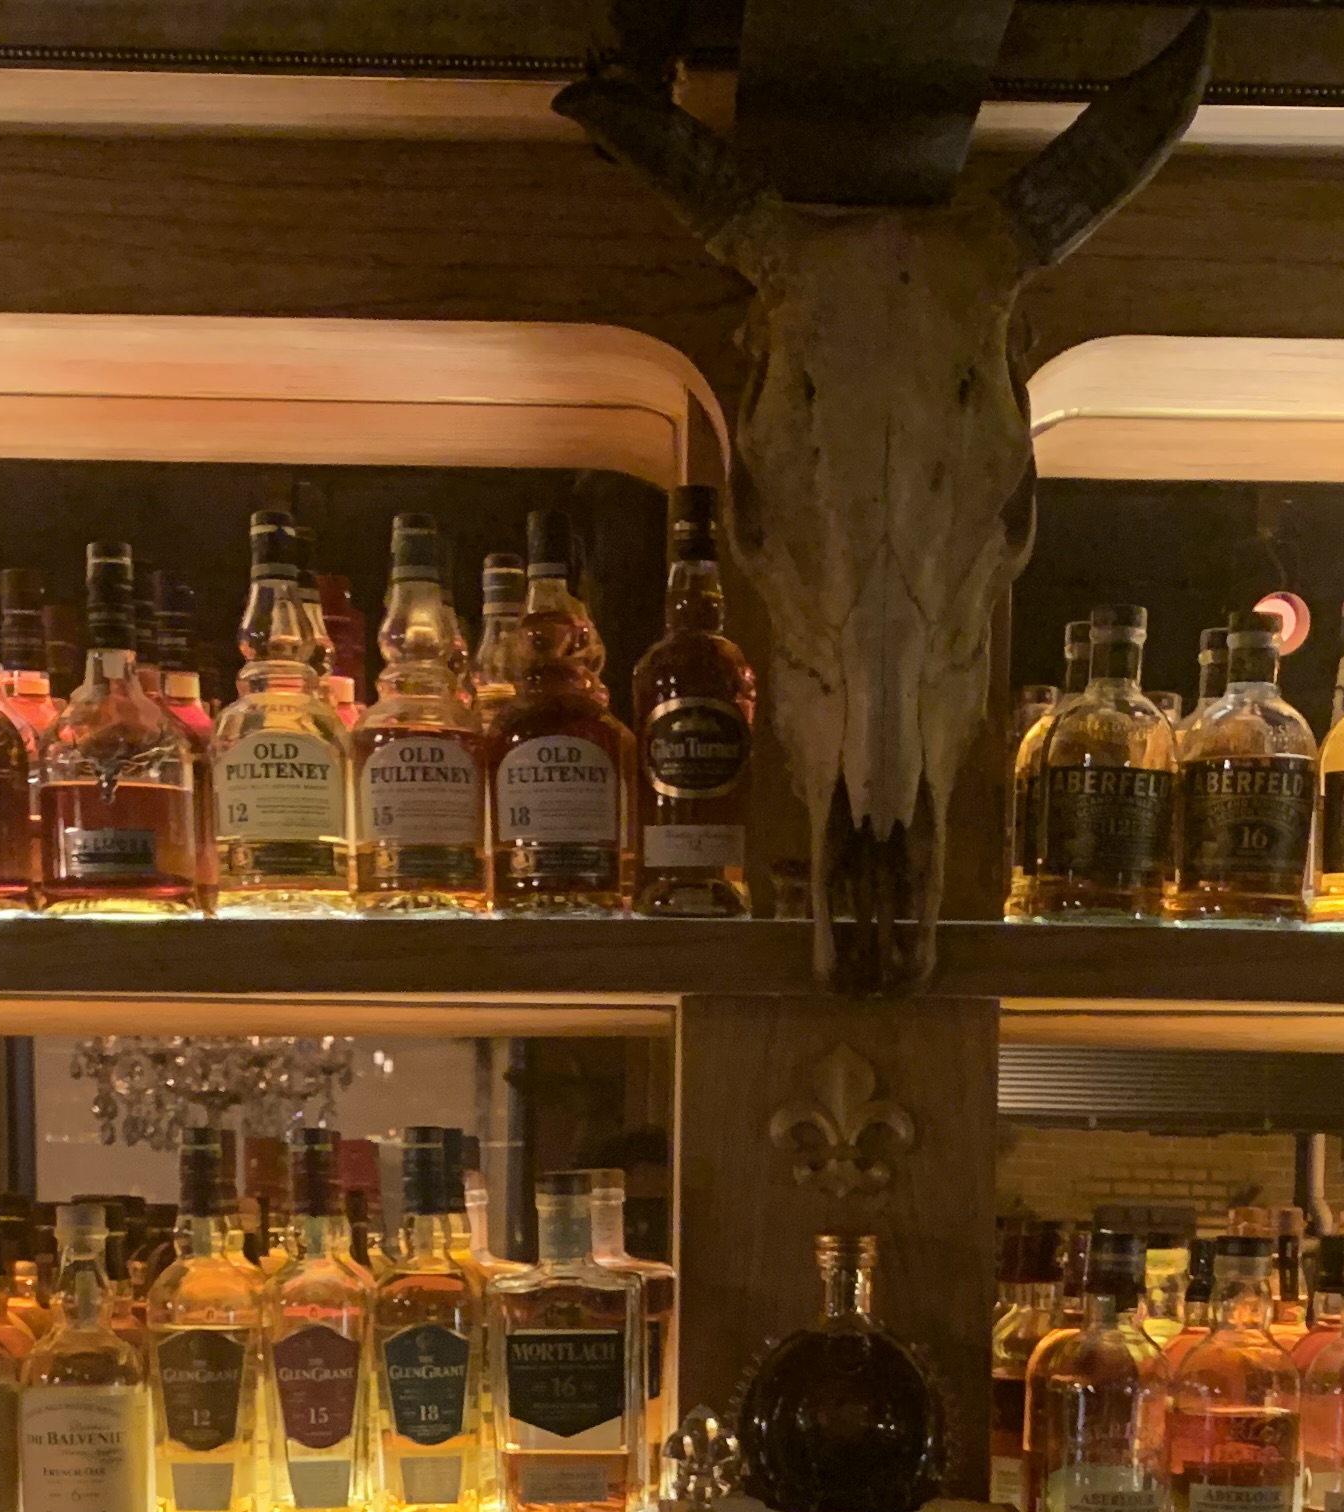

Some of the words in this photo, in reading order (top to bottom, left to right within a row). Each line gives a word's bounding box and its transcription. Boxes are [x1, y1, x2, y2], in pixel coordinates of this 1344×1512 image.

[253, 744, 299, 759] OLD
[399, 747, 444, 763] OLD
[537, 747, 582, 763] OLD
[226, 763, 331, 781] PULTENEY
[371, 767, 473, 784] PULTENEY
[508, 766, 609, 784] PULTENEY
[1054, 770, 1171, 798] ABERFELD
[227, 803, 248, 823] 12
[372, 806, 394, 826] 15
[509, 806, 531, 826] 18
[1240, 826, 1268, 848] 16
[512, 1343, 616, 1361] MORTLACH
[552, 1377, 576, 1396] 16
[192, 1409, 211, 1425] 12
[308, 1407, 329, 1424] 15
[418, 1405, 439, 1421] 18
[47, 1432, 127, 1445] BALVENIE
